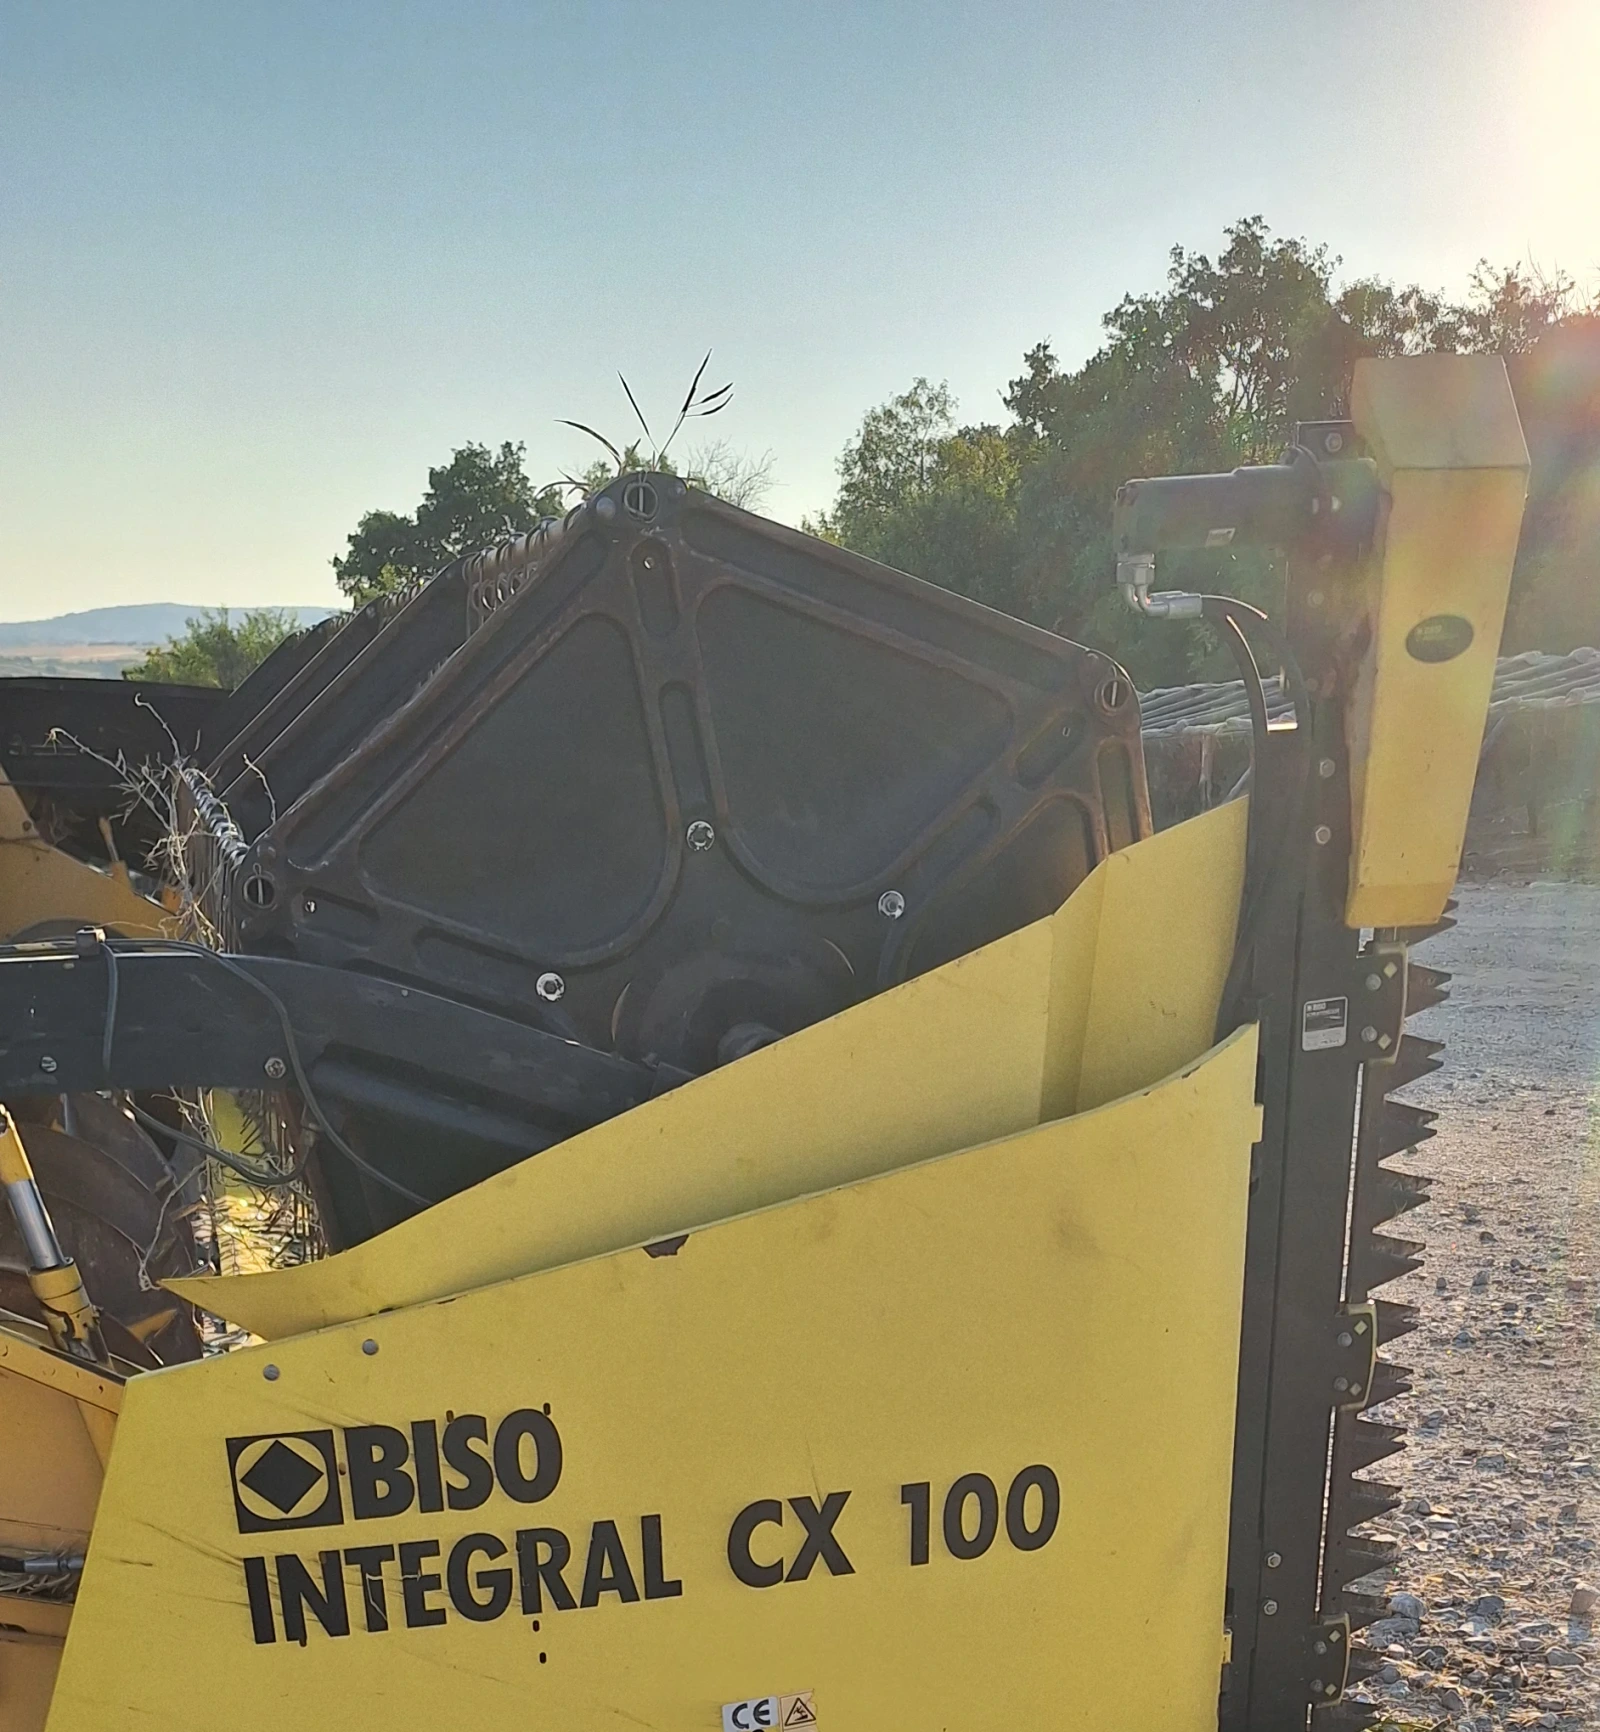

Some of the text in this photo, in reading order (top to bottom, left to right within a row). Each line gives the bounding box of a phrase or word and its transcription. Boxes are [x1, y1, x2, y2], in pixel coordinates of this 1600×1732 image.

[344, 1409, 562, 1520] BISO
[242, 1465, 1060, 1644] INTEGRAL CX 100
[732, 1699, 771, 1729] CE
